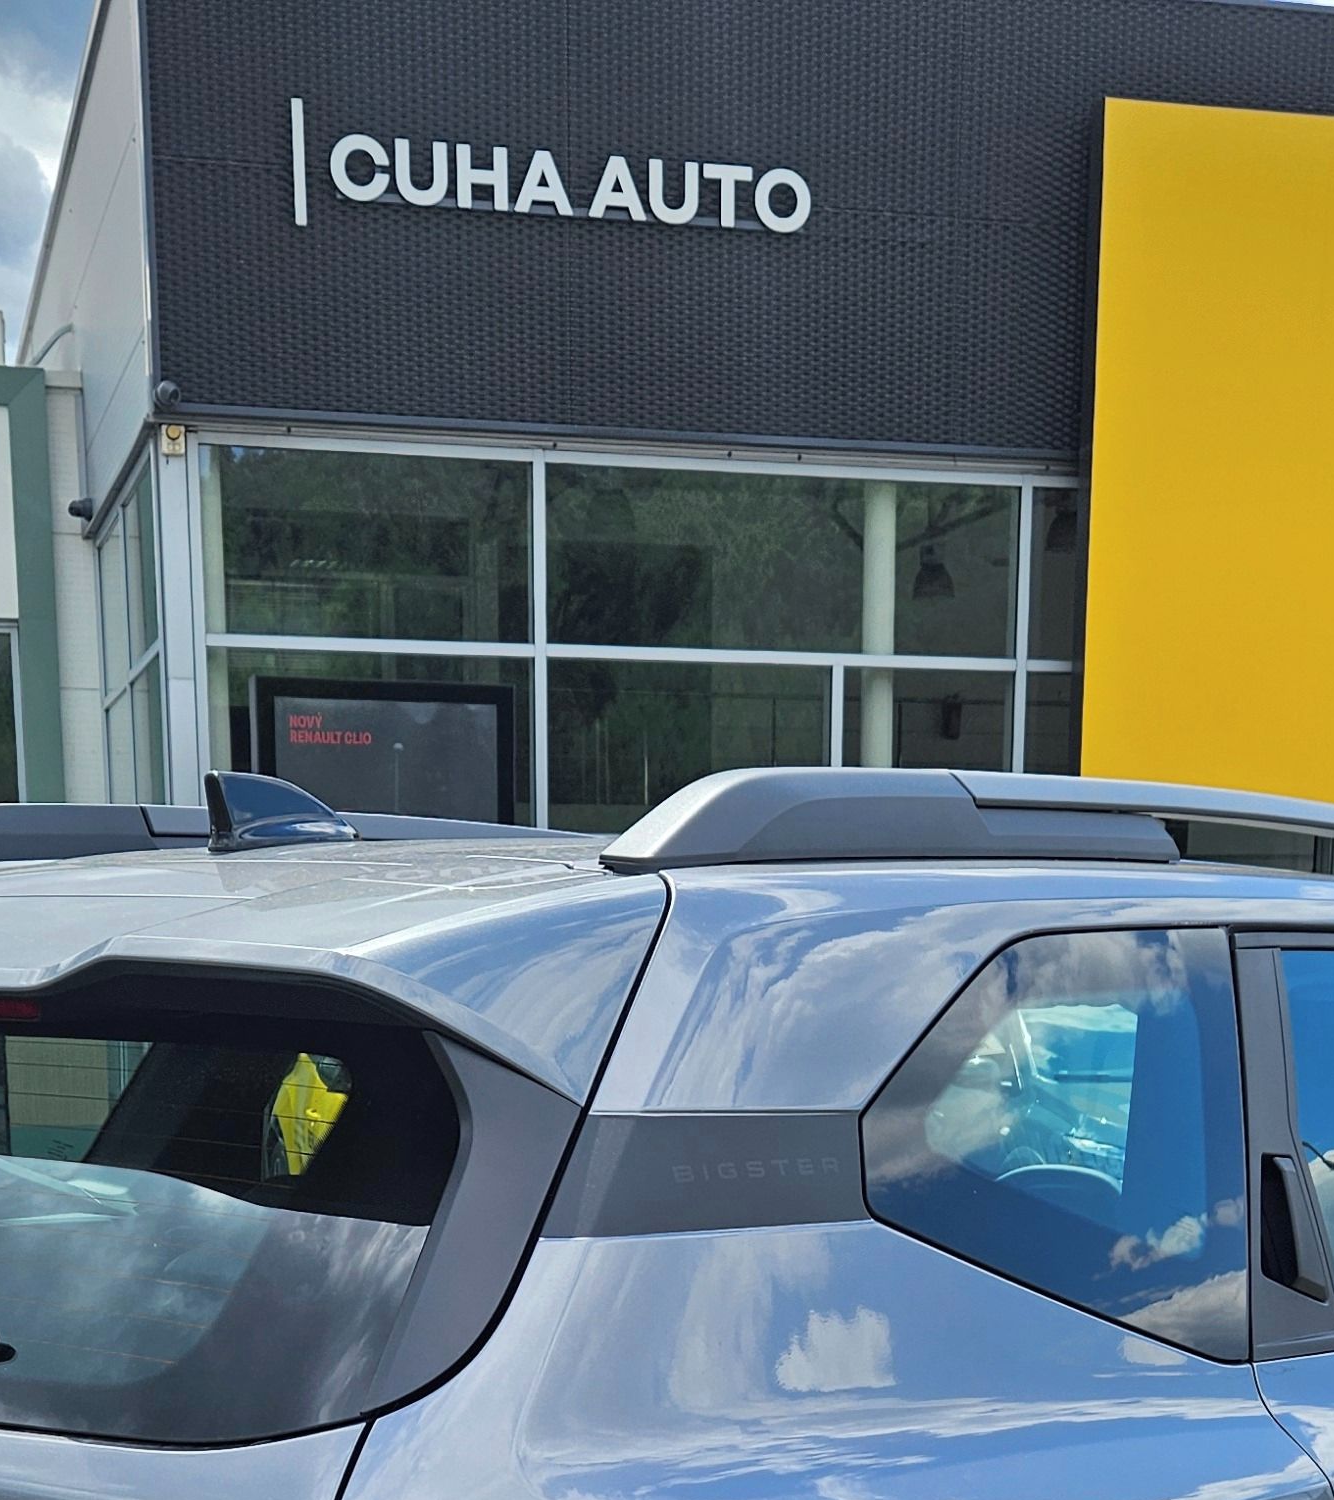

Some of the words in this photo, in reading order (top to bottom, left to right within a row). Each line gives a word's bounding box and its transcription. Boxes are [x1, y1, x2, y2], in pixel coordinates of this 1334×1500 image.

[329, 133, 573, 217] CUHA
[588, 155, 812, 234] AUTO
[289, 712, 323, 728] NOVÝ
[289, 730, 343, 745] RENAULT
[345, 731, 372, 745] CLIO
[671, 1157, 842, 1184] BIGSTER
